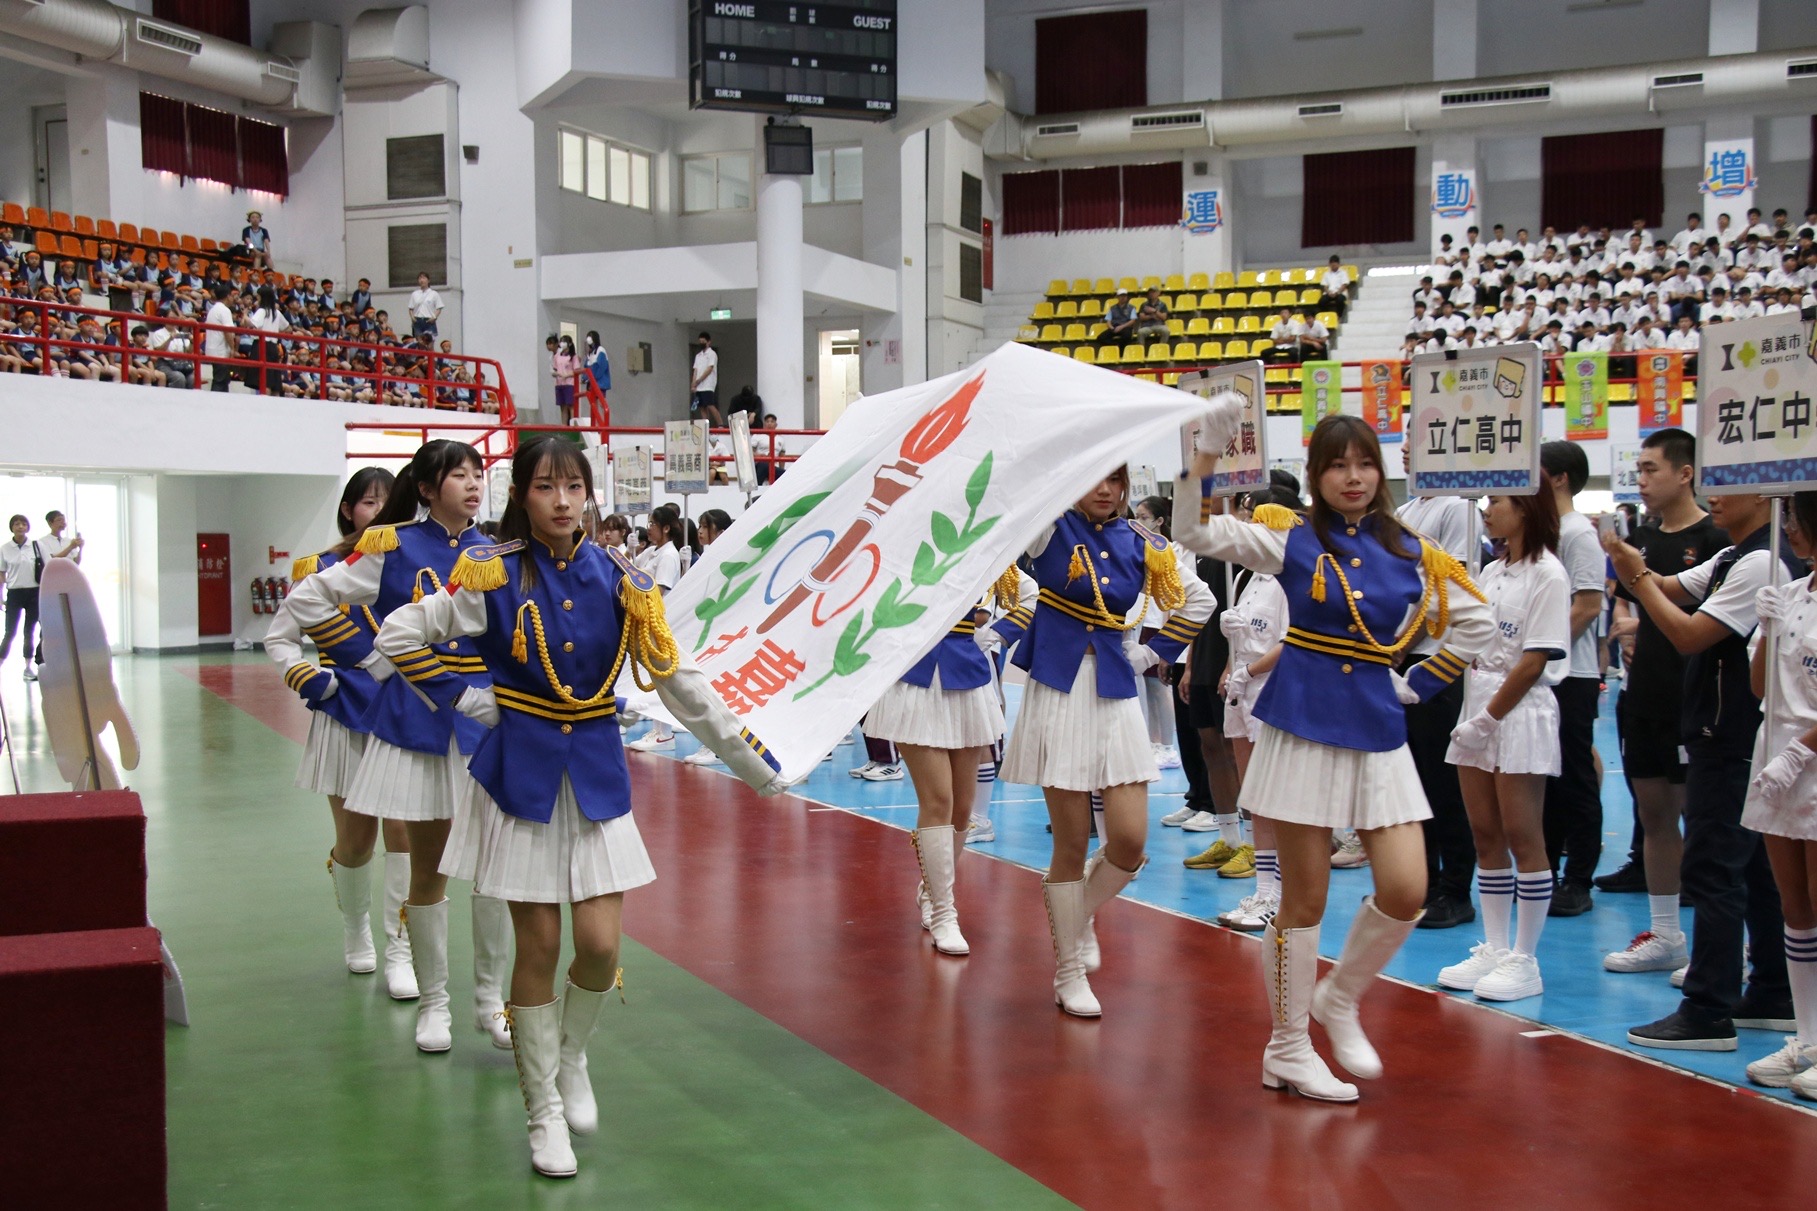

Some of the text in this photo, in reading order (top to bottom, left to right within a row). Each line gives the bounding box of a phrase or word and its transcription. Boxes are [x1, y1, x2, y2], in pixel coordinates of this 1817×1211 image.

[715, 3, 755, 18] HOME
[853, 15, 891, 30] GUEST
[1709, 149, 1745, 186] 增
[1436, 173, 1469, 208] 動
[1187, 191, 1217, 223] 運
[1761, 334, 1800, 354] 嘉義市
[1760, 353, 1800, 366] CHIAYI CITY
[1459, 368, 1489, 382] 嘉義市
[1717, 391, 1817, 445] 宏仁中
[1428, 413, 1522, 455] 立仁高中
